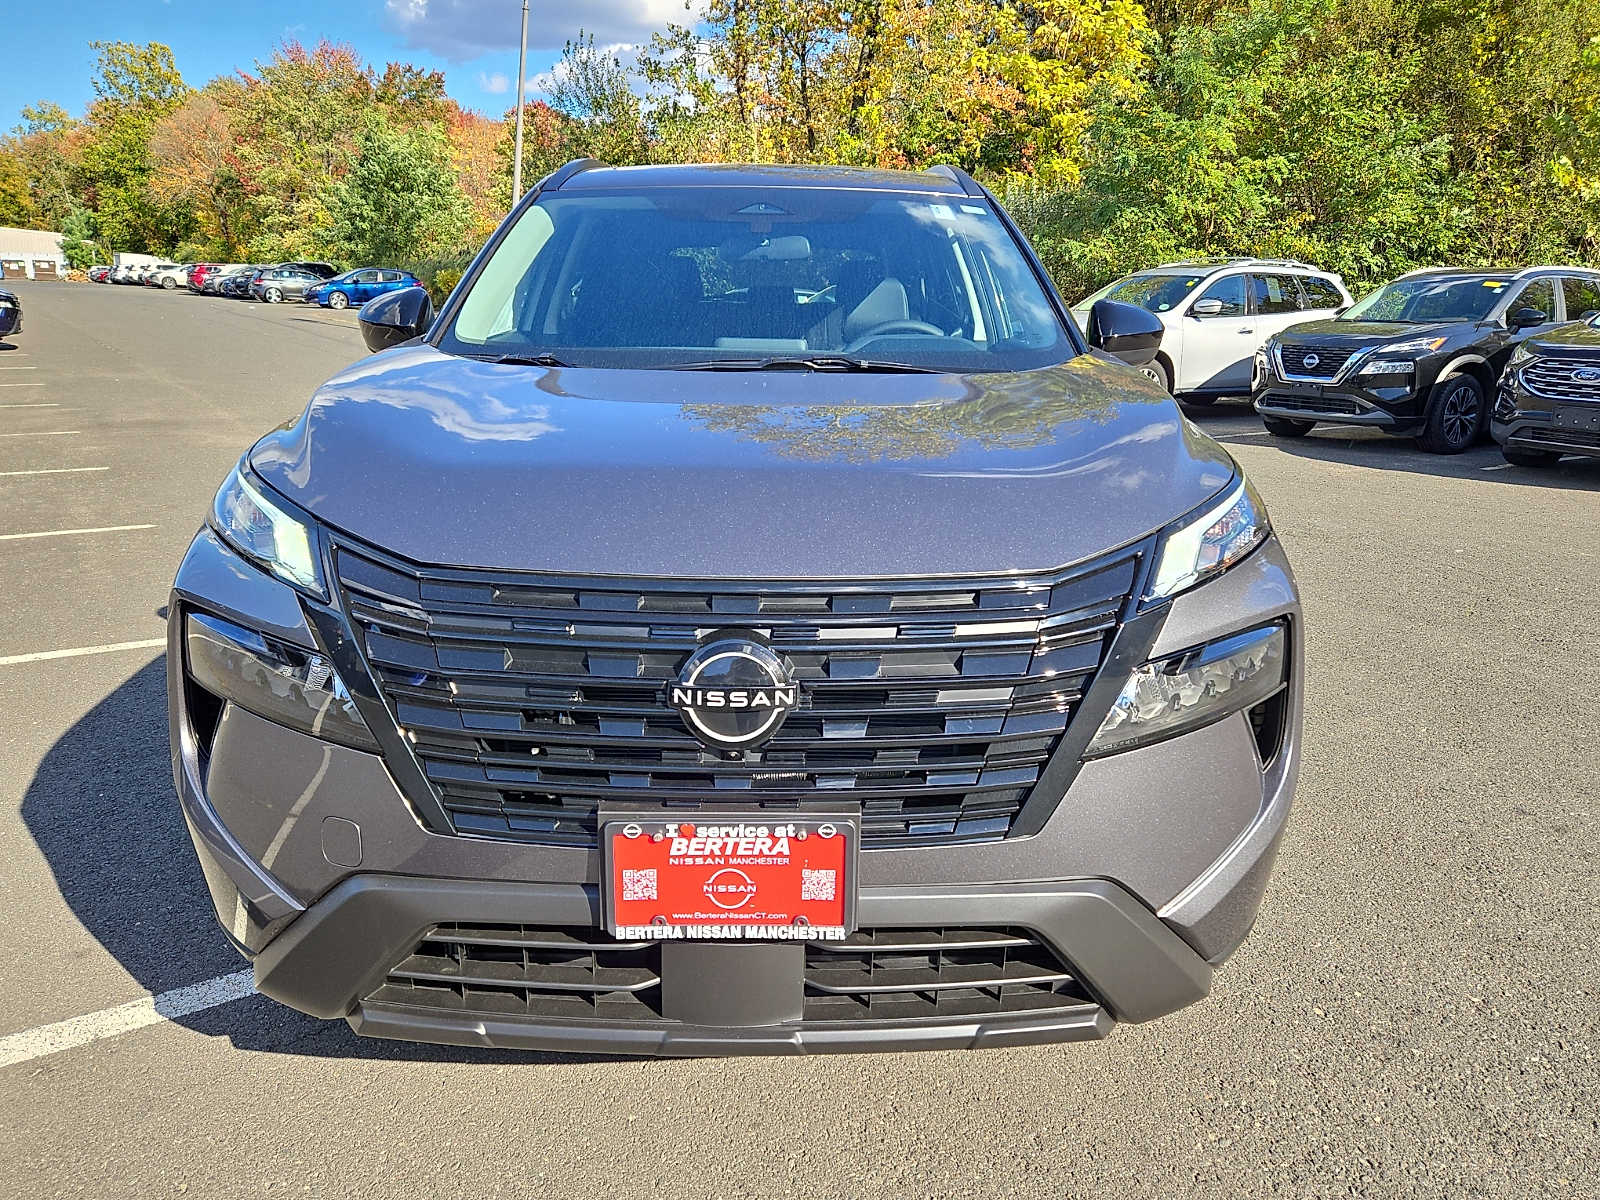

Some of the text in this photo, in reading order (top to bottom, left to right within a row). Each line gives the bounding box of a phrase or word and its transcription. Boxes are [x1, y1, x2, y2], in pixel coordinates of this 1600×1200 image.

[673, 688, 794, 708] NISSAN
[665, 824, 796, 838] I service at
[669, 837, 791, 856] BERTERA
[669, 857, 790, 865] NISSAN MANCHESTER
[703, 884, 757, 893] NISSAN
[672, 911, 788, 920] www.BerteraNissanCT.com
[615, 925, 846, 941] BERTERA NISSAN MANCHESTER
